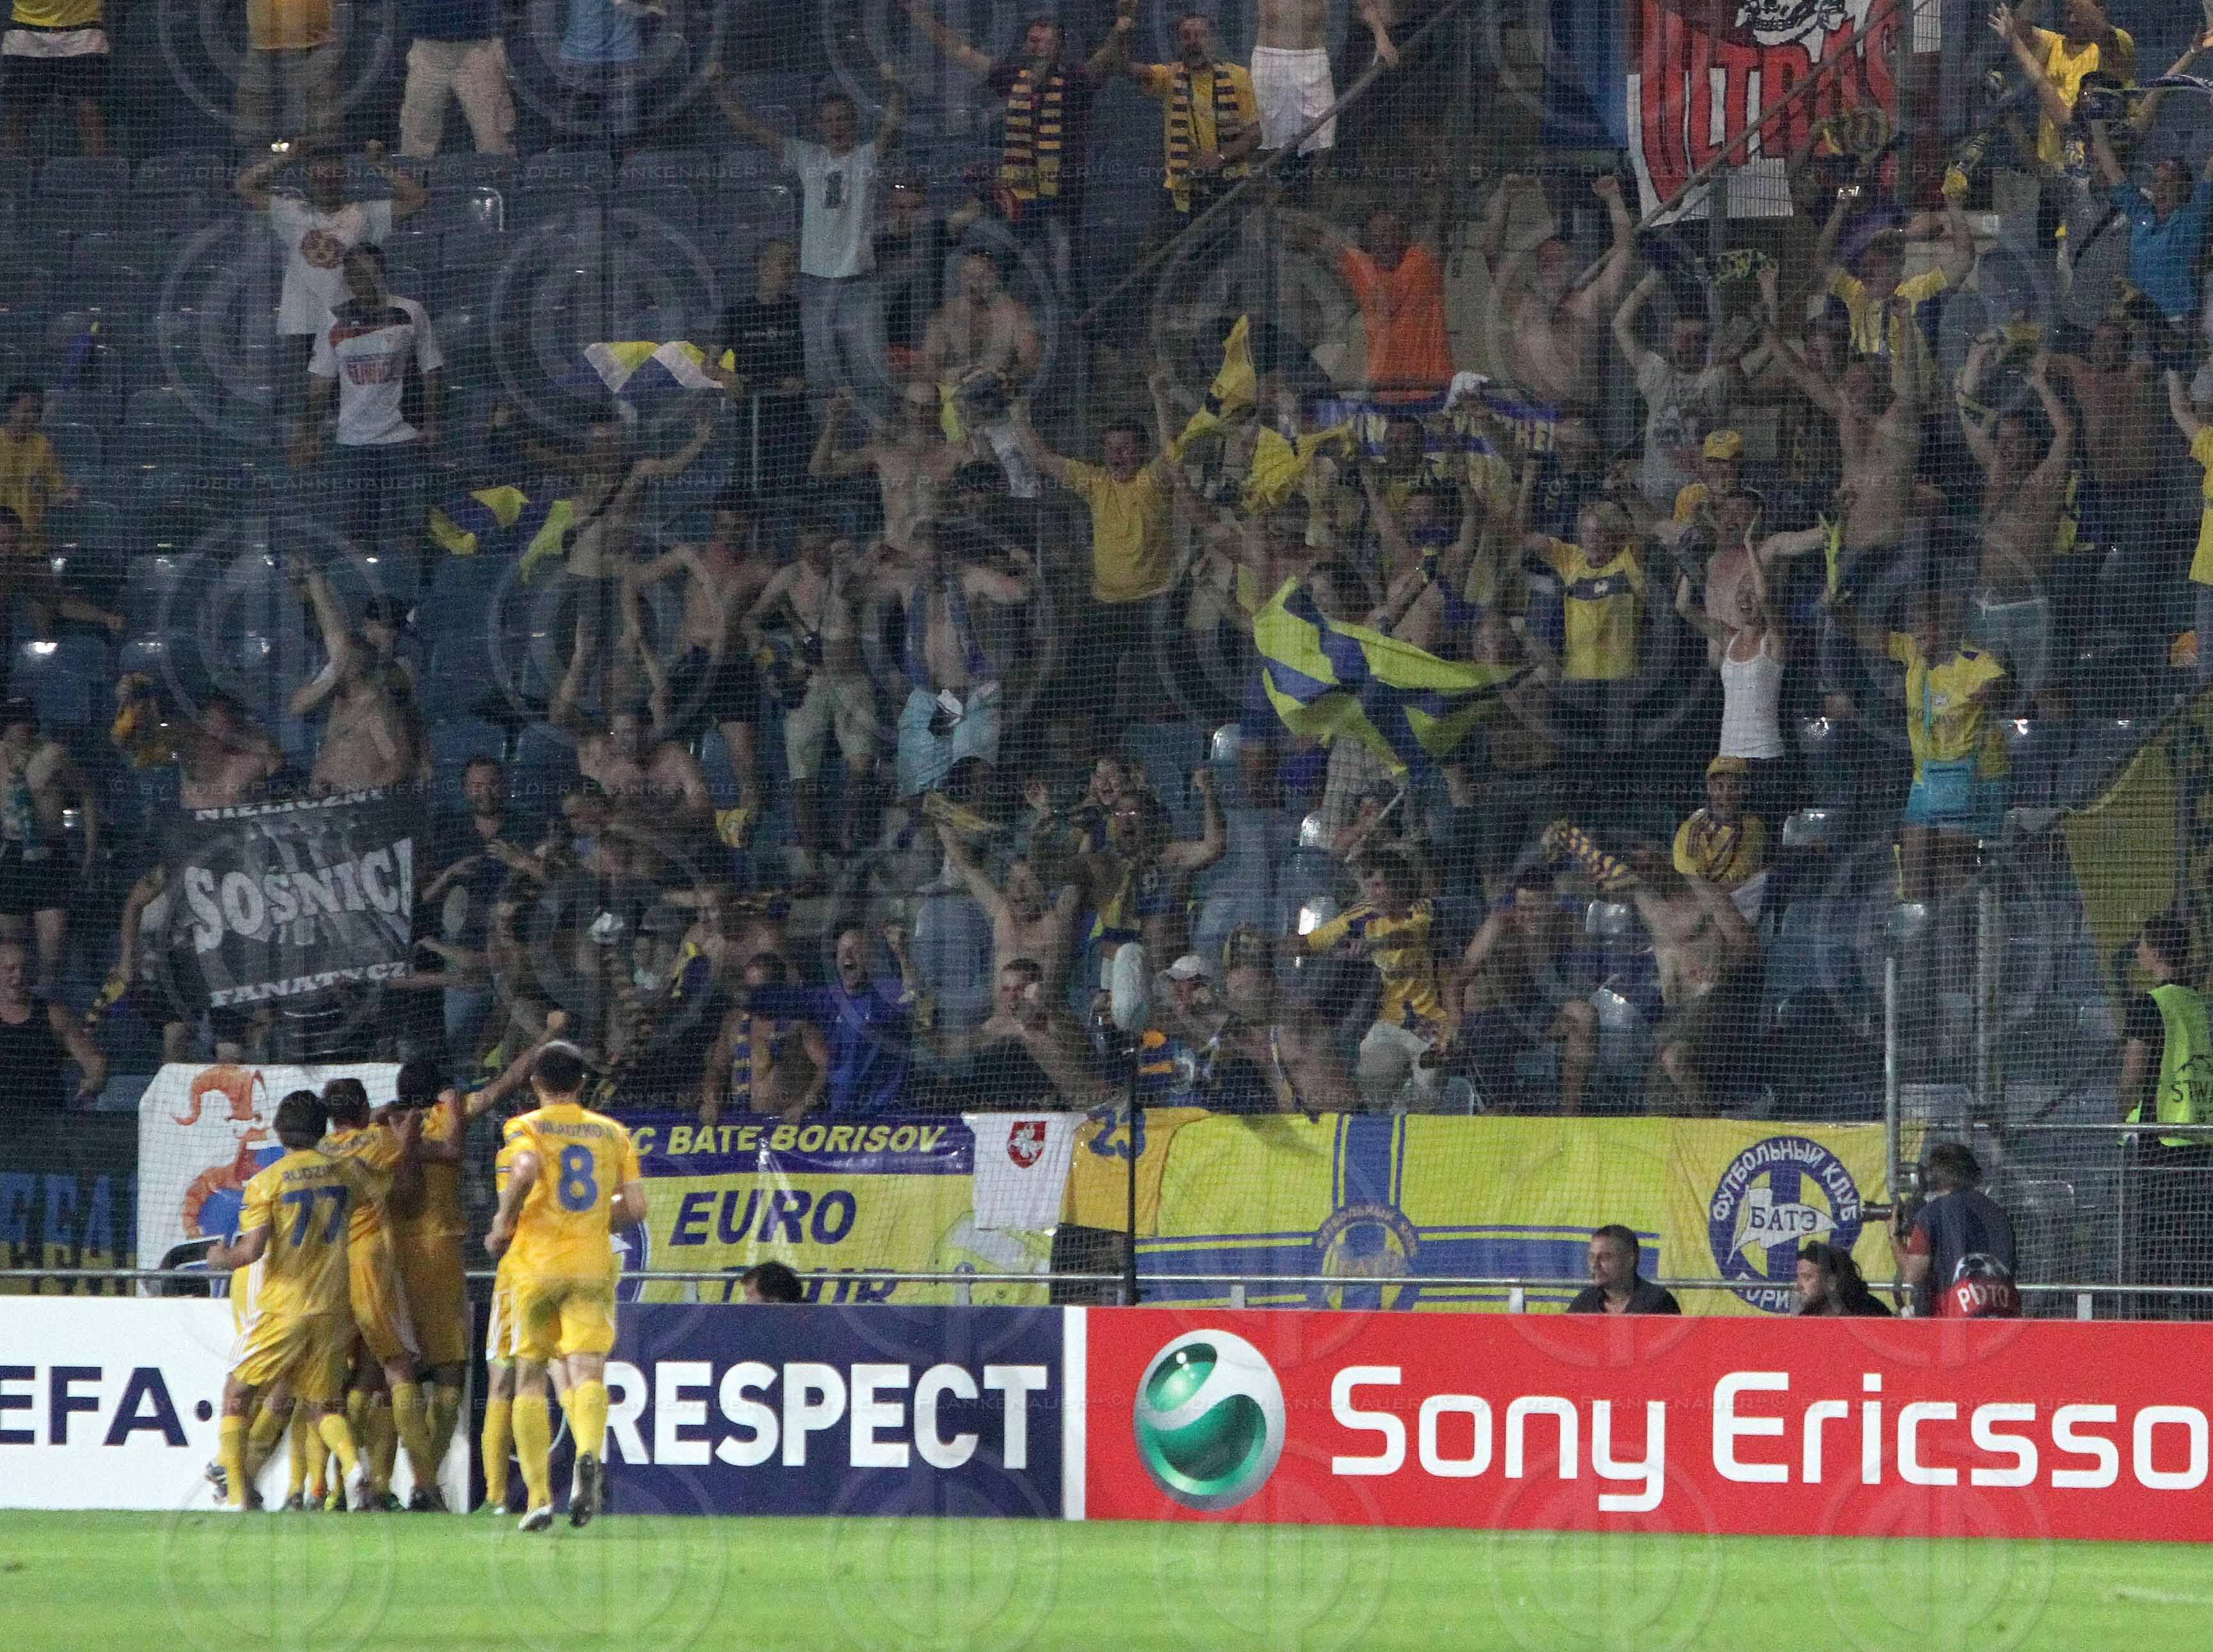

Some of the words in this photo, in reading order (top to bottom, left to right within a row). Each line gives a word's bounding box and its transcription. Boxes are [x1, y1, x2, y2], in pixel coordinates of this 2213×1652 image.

[666, 1126, 765, 1154] BATE
[769, 1124, 949, 1154] BORISOV
[556, 1144, 599, 1212] 8
[1712, 1140, 1826, 1221] ФУТБОЛЬНЫЙ
[1821, 1162, 1858, 1222] КЛУБ
[282, 1185, 350, 1247] 77
[669, 1188, 858, 1246] EURO
[1749, 1206, 1819, 1232] БАТЭ
[602, 1361, 1048, 1469] RESPECT
[1330, 1365, 1666, 1512] Sony
[1712, 1371, 2209, 1491] Ericsso
